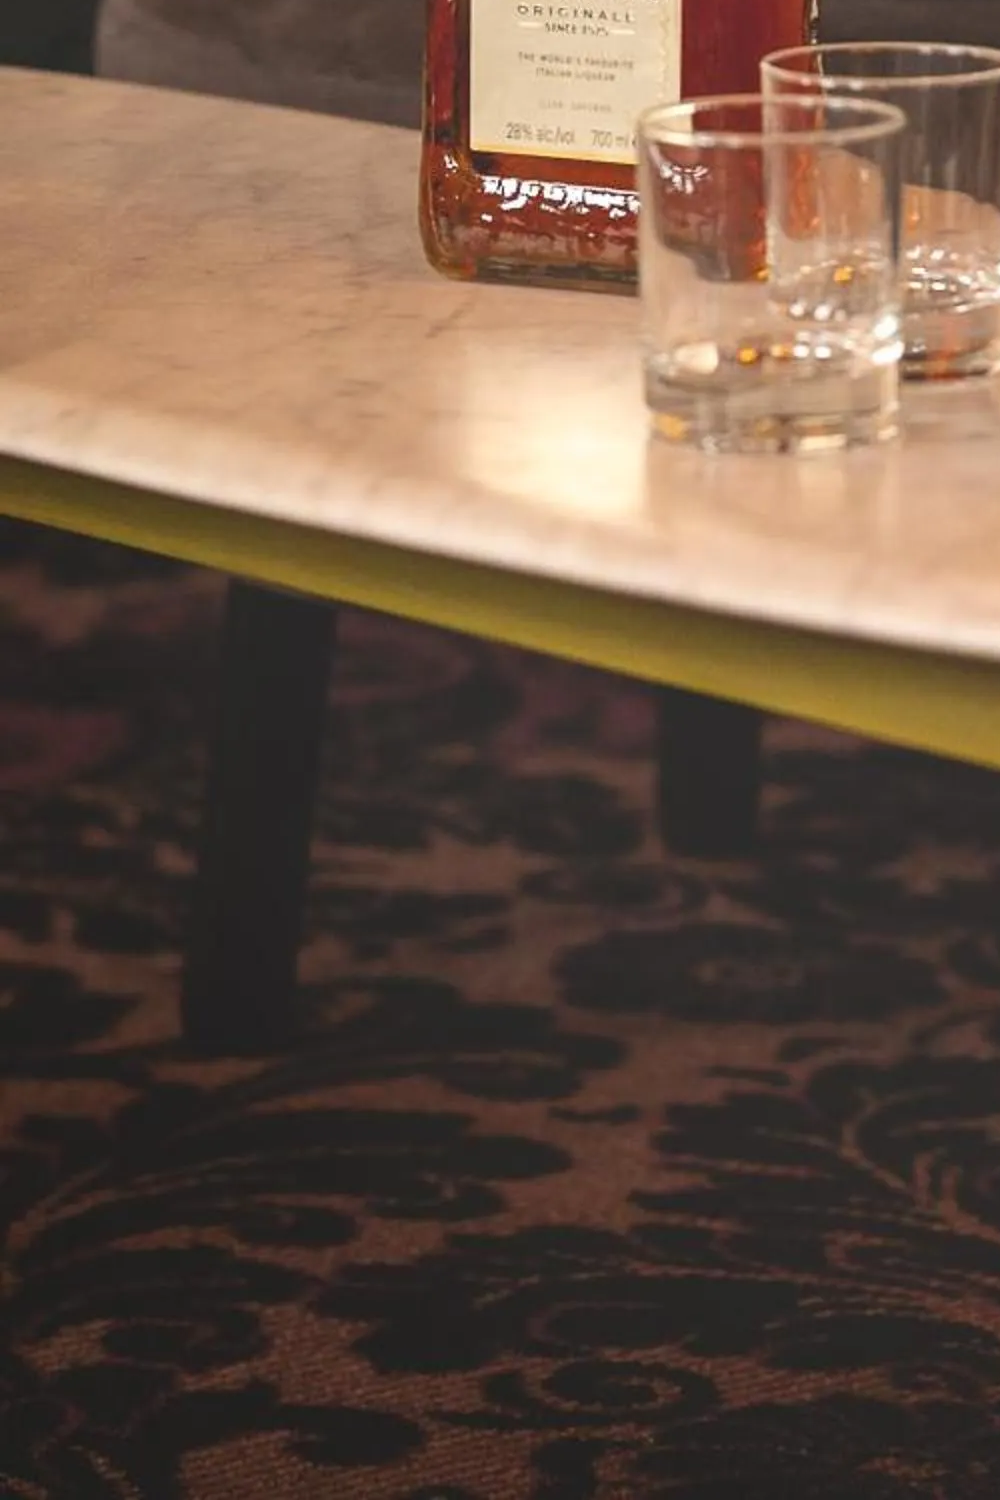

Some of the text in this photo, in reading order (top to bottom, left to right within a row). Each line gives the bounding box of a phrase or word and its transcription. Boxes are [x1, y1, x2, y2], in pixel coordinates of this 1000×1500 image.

[517, 5, 634, 24] ORIGINALL
[545, 21, 577, 35] SINCE
[590, 128, 613, 148] 700
